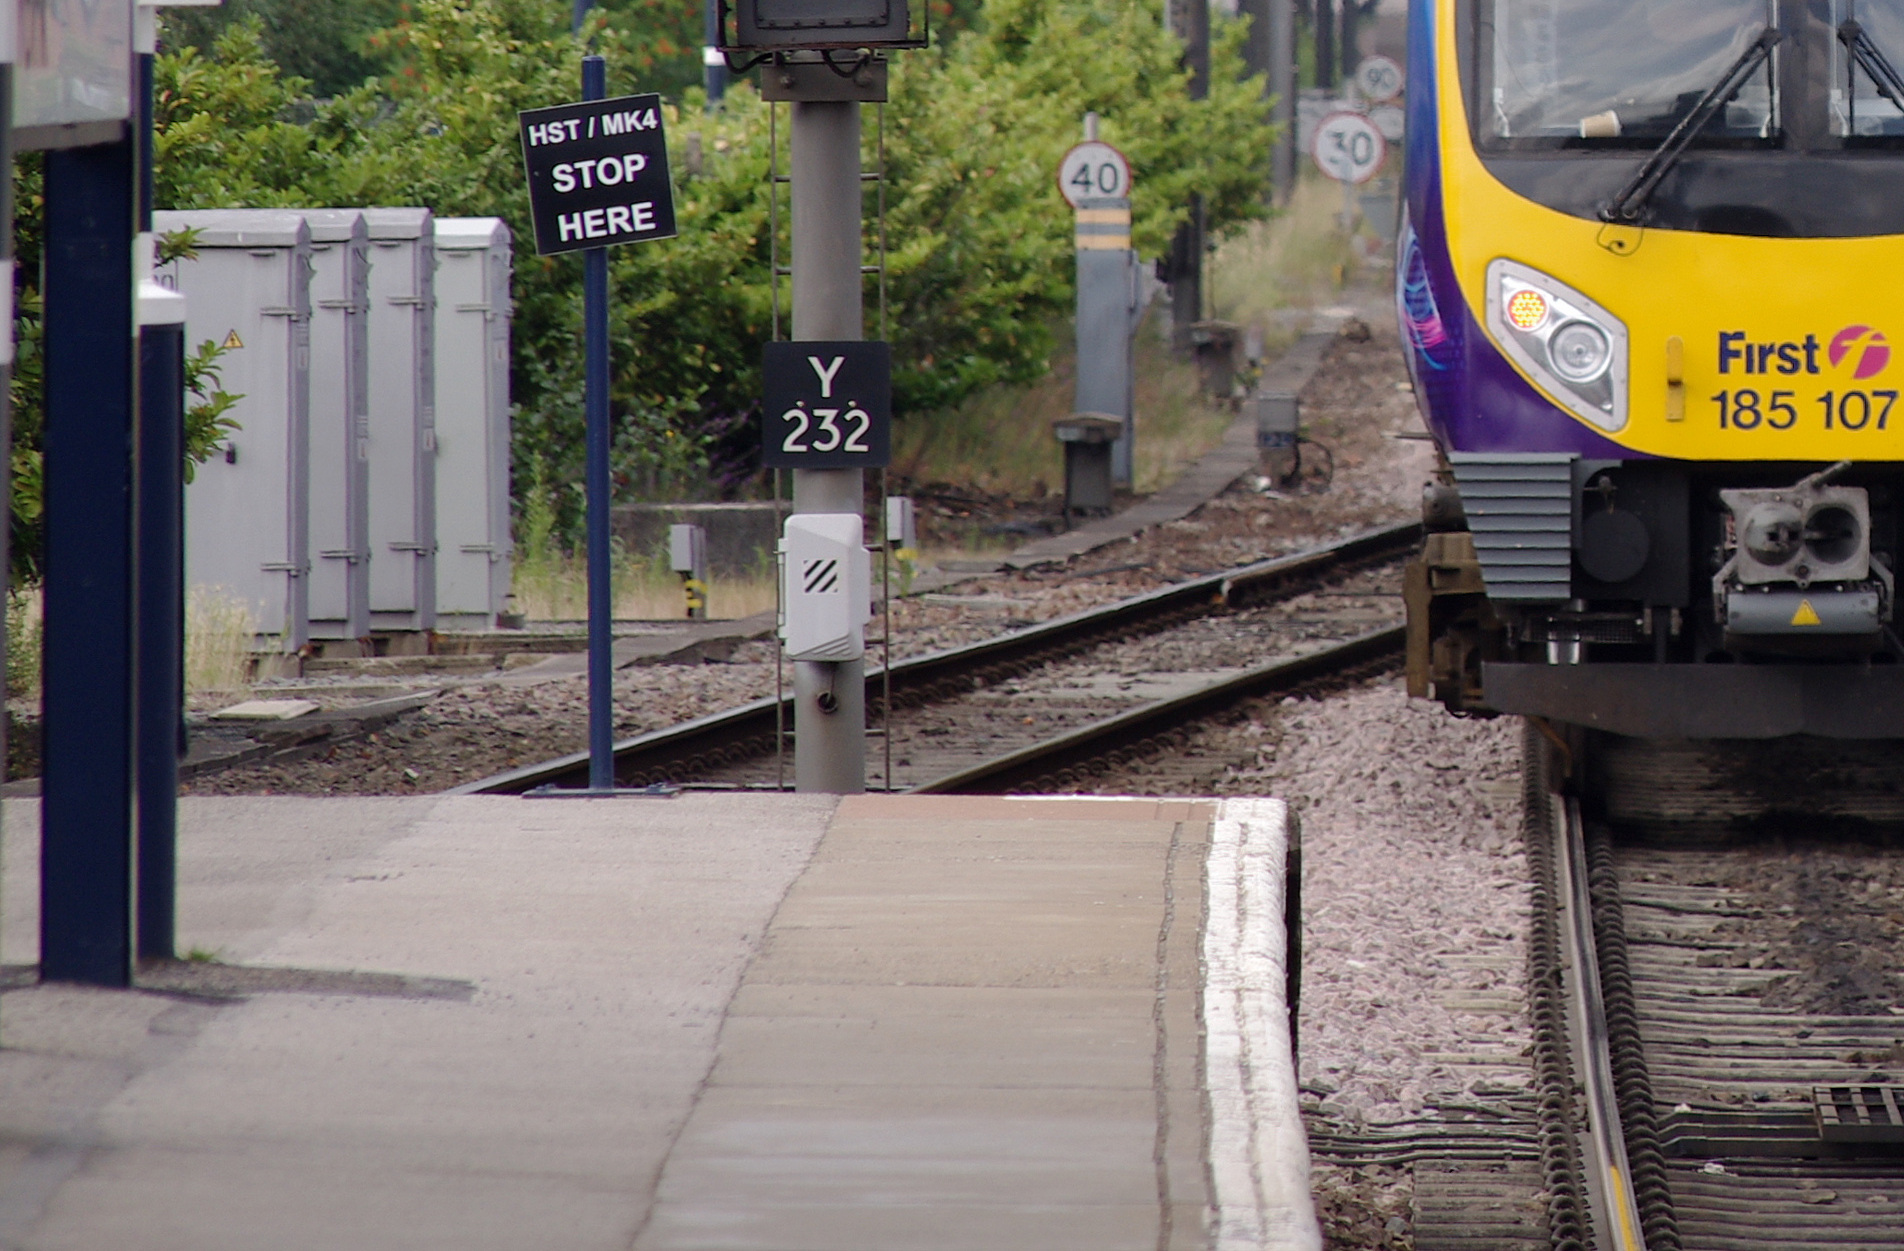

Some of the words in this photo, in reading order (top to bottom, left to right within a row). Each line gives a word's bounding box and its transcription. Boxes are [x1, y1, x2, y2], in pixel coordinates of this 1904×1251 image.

[527, 118, 582, 147] HST
[587, 115, 596, 138] /
[601, 108, 659, 136] MK4
[1329, 131, 1374, 166] 30
[552, 154, 647, 193] STOP
[1071, 163, 1119, 194] 40
[557, 202, 656, 243] HERE
[1719, 332, 1820, 376] First
[807, 356, 845, 398] Y
[782, 408, 871, 453] 232
[1712, 390, 1797, 430] 185
[1818, 390, 1899, 431] 107
